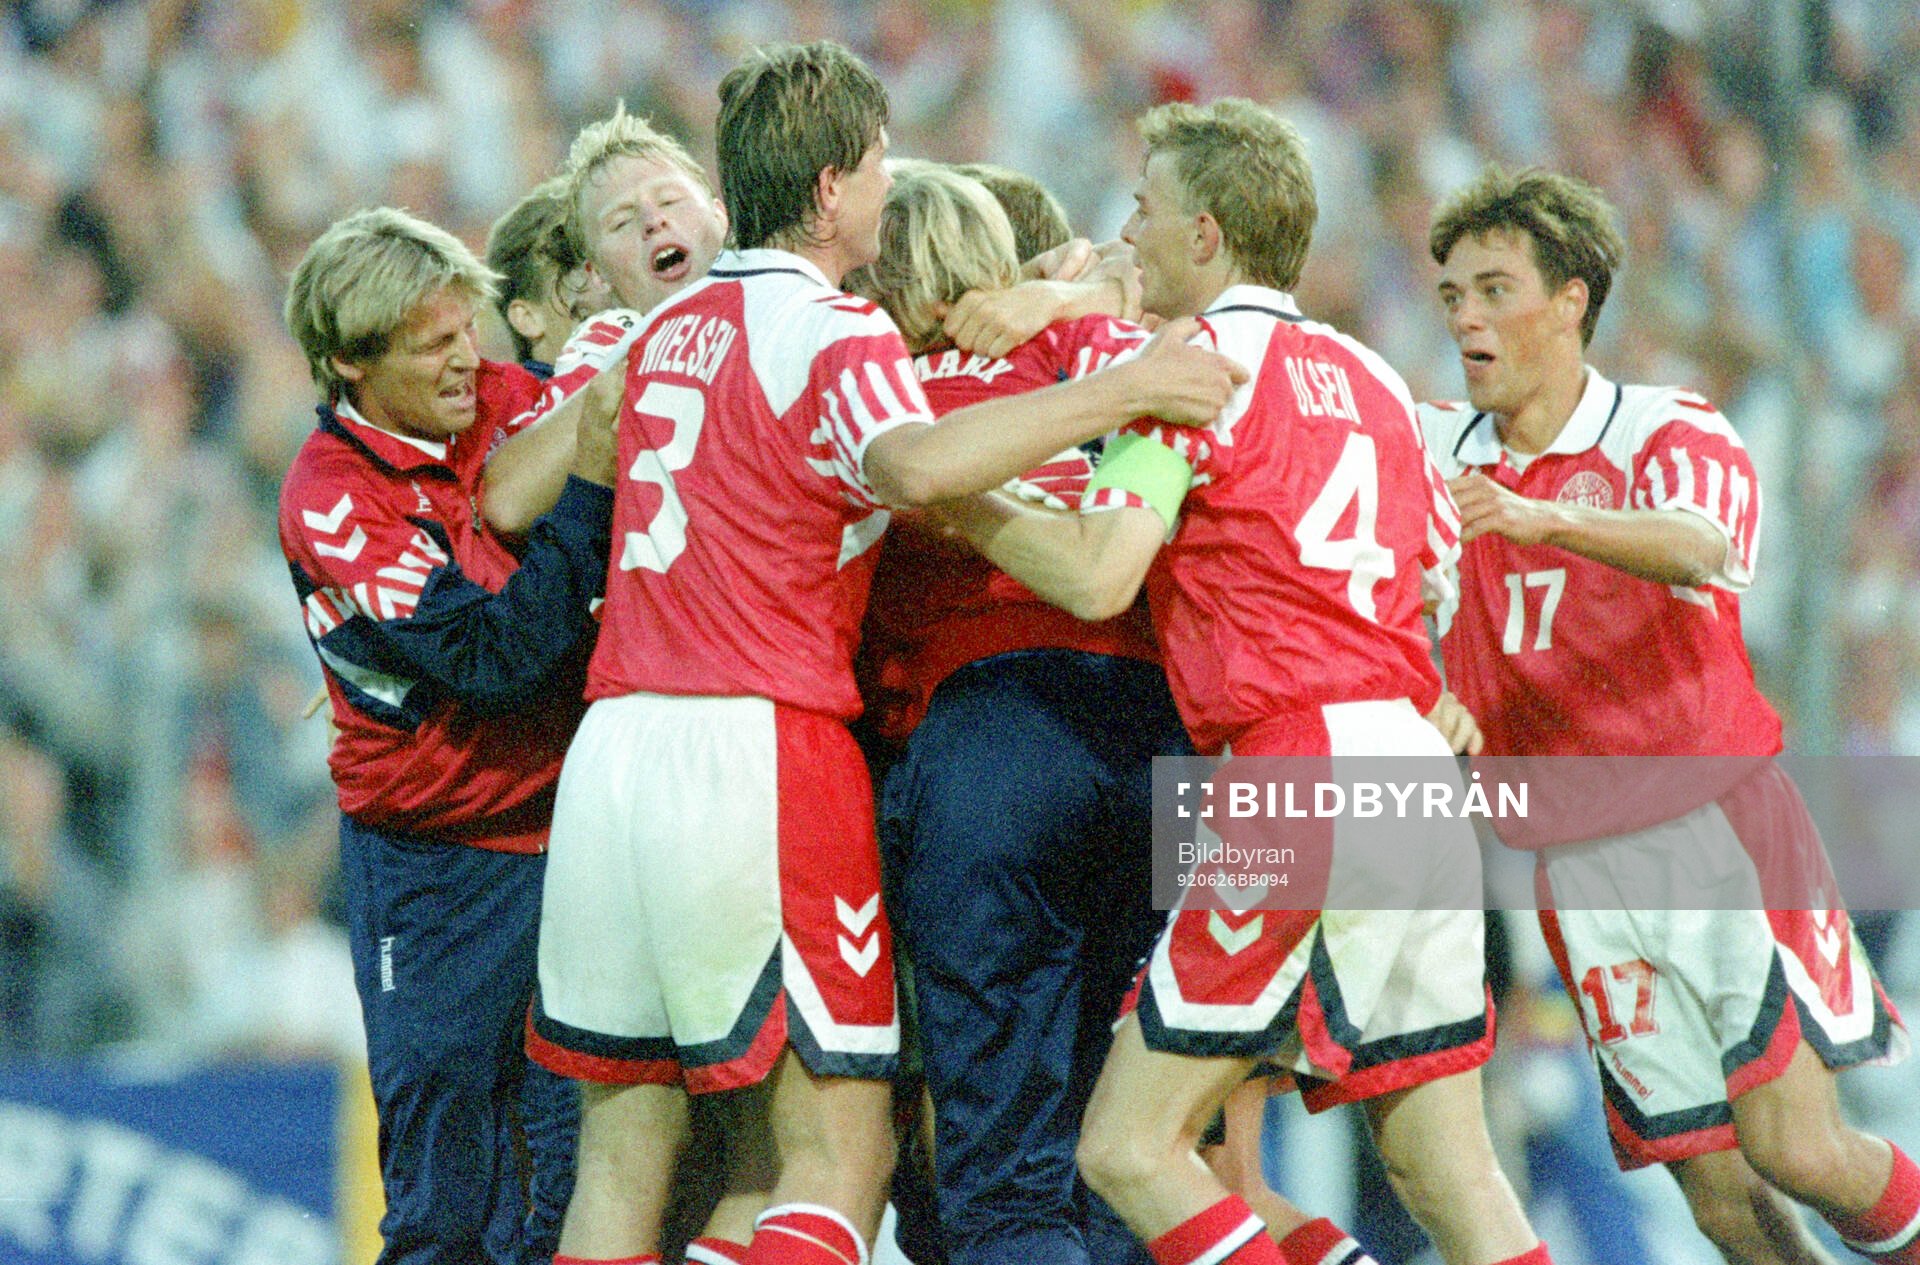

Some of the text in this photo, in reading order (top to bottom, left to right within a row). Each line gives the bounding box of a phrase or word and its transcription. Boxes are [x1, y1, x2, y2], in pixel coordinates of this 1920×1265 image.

[637, 314, 737, 386] NIELSEN
[1285, 356, 1362, 425] OLSEN
[619, 381, 705, 574] 3
[1294, 430, 1396, 624] 4
[1503, 568, 1566, 654] 17
[381, 936, 396, 992] hummel
[1581, 959, 1660, 1046] 17
[1611, 1052, 1654, 1100] hummel
